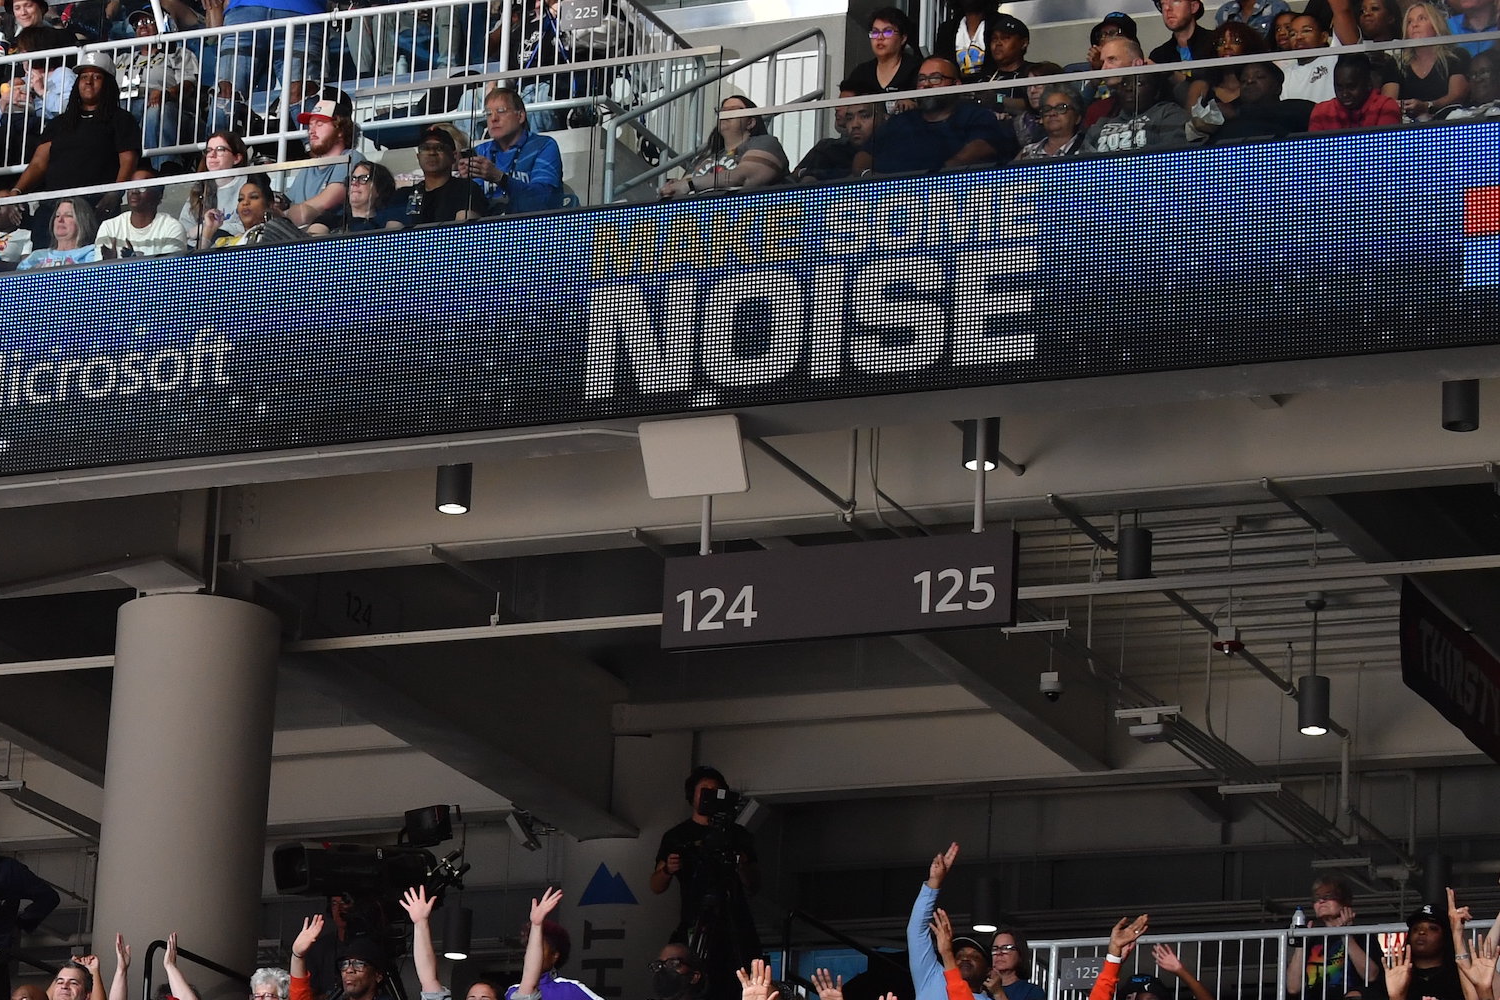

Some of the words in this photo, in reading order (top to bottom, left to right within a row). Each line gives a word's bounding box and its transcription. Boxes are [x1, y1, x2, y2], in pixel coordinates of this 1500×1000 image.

[574, 6, 599, 20] 225
[1097, 129, 1147, 153] 2024
[592, 204, 802, 278] MAKE
[820, 184, 1041, 256] SOME
[583, 247, 1041, 402] NOISE
[676, 585, 758, 632] 124
[913, 566, 996, 614] 125
[1076, 967, 1099, 979] 125
